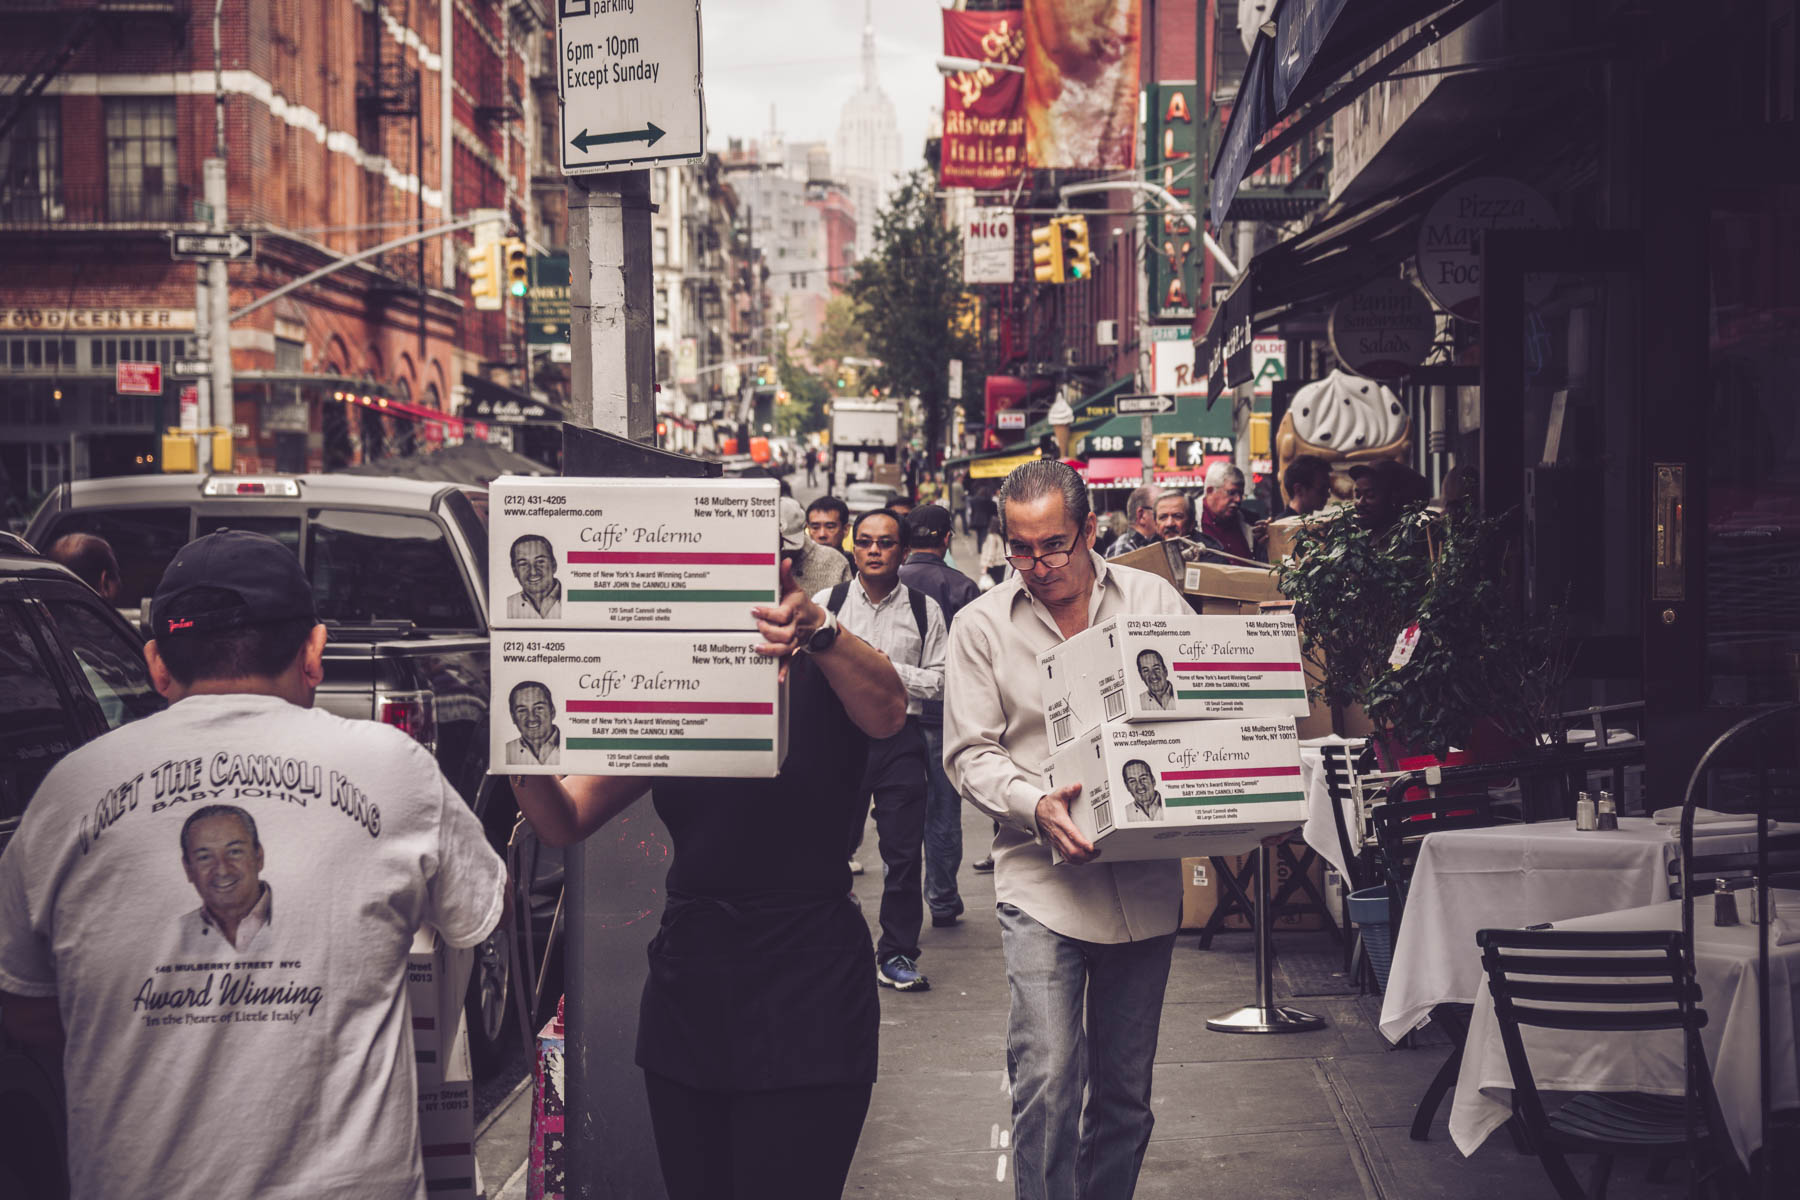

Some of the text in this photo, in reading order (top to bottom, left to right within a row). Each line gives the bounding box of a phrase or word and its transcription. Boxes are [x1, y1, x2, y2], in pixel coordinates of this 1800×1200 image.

[566, 41, 594, 65] 6pm
[606, 35, 639, 60] 10pm
[567, 60, 660, 89] Except Sunday
[1164, 92, 1192, 308] ALLEVA
[1458, 194, 1525, 219] Pizza
[74, 310, 170, 327] CENTER
[1360, 330, 1410, 354] Salads
[1092, 436, 1123, 452] 188
[504, 495, 566, 505] (212) 431-4205
[694, 496, 775, 508] 148 Mulberry Street
[503, 507, 602, 517] www.caffepalermo.com
[694, 508, 775, 517] New York, NY 10013
[632, 523, 702, 542] Palermo
[656, 571, 682, 579] Winning
[593, 580, 611, 589] BABY
[611, 581, 630, 589] JOHN
[629, 581, 640, 589] the
[642, 581, 669, 589] CANNOLI
[503, 641, 565, 652] (212) 431-4205
[692, 643, 707, 652] 148
[709, 643, 746, 654] Mulberry
[1210, 641, 1254, 654] Palermo
[502, 653, 600, 664] www.caffepalermo.com
[692, 655, 710, 664] New
[712, 655, 732, 664] York,
[734, 656, 745, 664] NY
[630, 670, 699, 690] Palermo
[654, 718, 680, 726] Winning
[1128, 729, 1155, 737] 431-4205
[1251, 725, 1276, 733] Mulberry
[1277, 724, 1295, 732] Street
[1113, 738, 1180, 746] www.caffepalermo.com
[1202, 748, 1249, 761] Palermo
[94, 773, 144, 840] MET
[150, 758, 202, 798] THE
[210, 752, 322, 798] CANNOLI
[330, 770, 381, 838] KING
[151, 788, 308, 813] BABY JOHN
[174, 962, 230, 972] MULBERRY
[234, 961, 274, 970] STREET
[280, 961, 302, 969] NYC
[133, 972, 324, 1016] Award Winning
[162, 1014, 182, 1025] the
[185, 1012, 216, 1026] Heart
[219, 1012, 233, 1024] of
[235, 1010, 268, 1022] Little
[440, 1089, 468, 1098] Street
[441, 1100, 469, 1110] 10013
